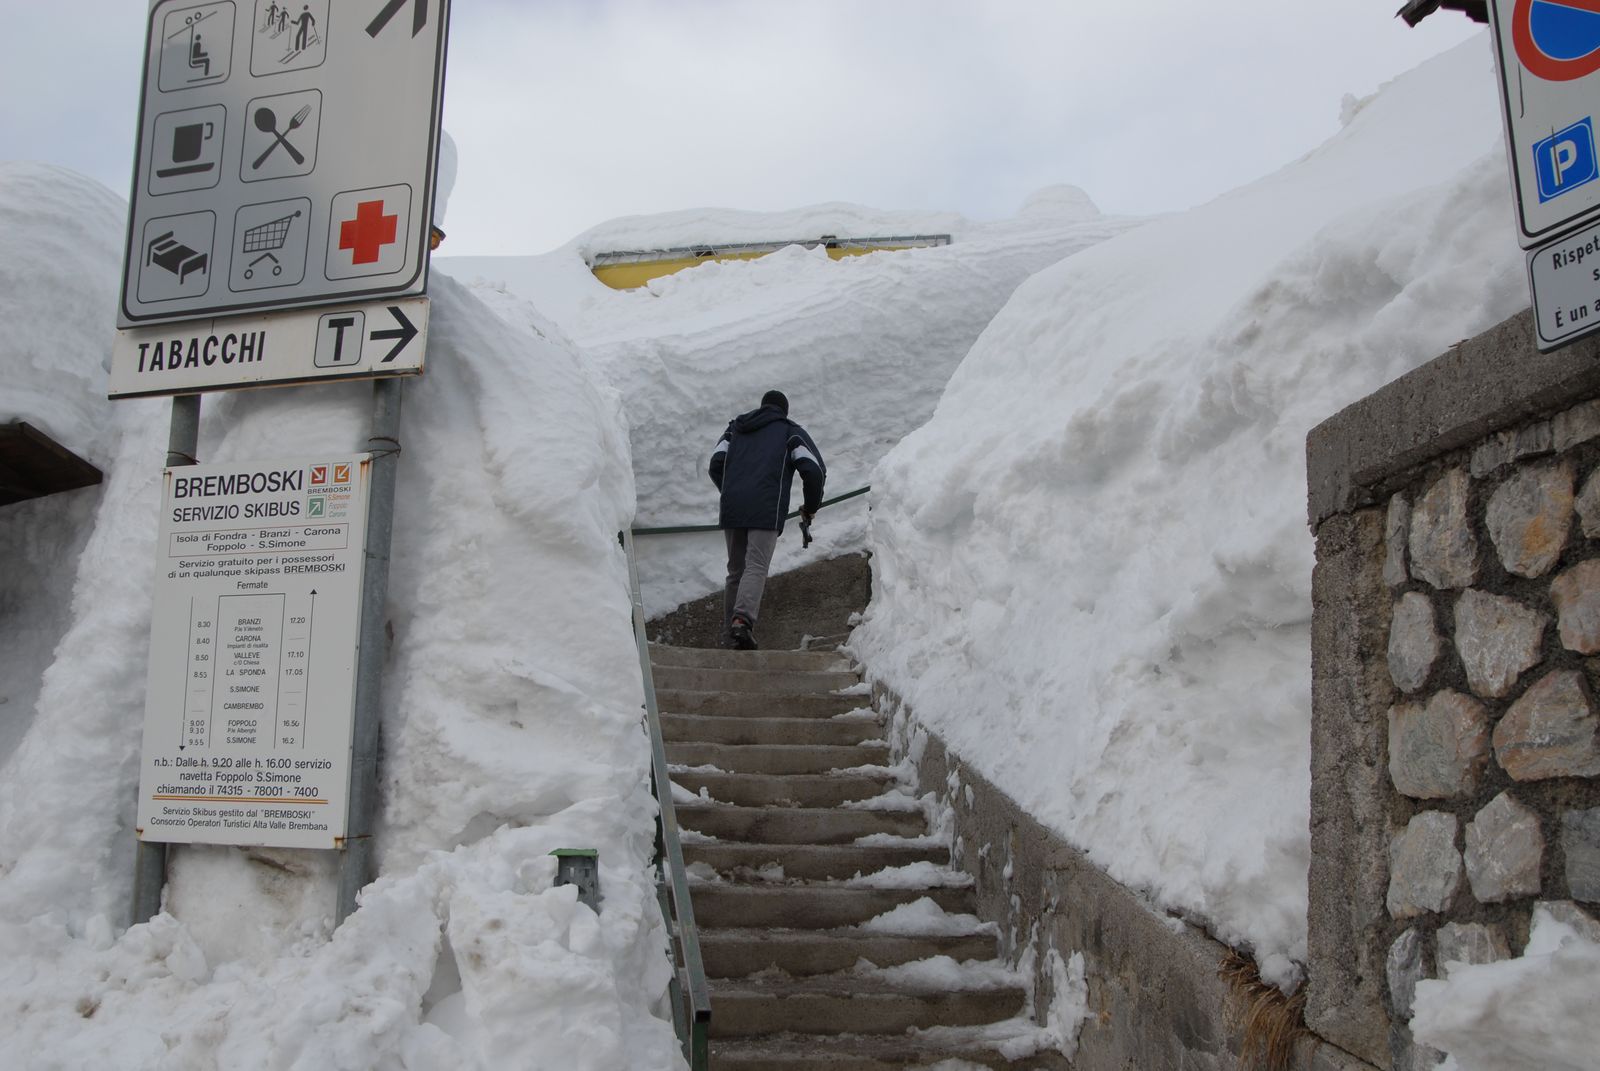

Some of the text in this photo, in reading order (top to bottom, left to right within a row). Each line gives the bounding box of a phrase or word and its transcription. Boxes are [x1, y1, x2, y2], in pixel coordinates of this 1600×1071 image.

[1550, 139, 1577, 186] P
[1570, 305, 1588, 322] un
[328, 317, 355, 361] T
[138, 331, 266, 372] TABACCHI
[174, 469, 303, 498] BREMBOSKI
[307, 486, 351, 494] BREMBOSKI
[172, 500, 300, 522] SERVIZIO SKIBUS
[176, 535, 199, 543] Isola
[202, 534, 211, 542] di
[213, 532, 247, 541] Fondra
[260, 529, 291, 538] Branzi
[303, 527, 341, 536] Carona
[207, 542, 246, 553] Foppolo
[258, 539, 306, 549] S.Simone
[179, 560, 215, 568] Servizio
[218, 557, 254, 569] gratuito
[257, 558, 273, 567] per
[281, 554, 335, 566] possessori
[168, 571, 176, 579] di
[193, 568, 241, 579] qualunque
[244, 566, 280, 576] skipass
[284, 564, 346, 574] BREMBOSKI
[237, 580, 268, 590] Fermate
[286, 668, 303, 676] 17.05
[223, 702, 264, 710] CAMBREMBO
[154, 757, 332, 769] n.b.: Dalle h. 9.20 alle h. 16.00 servizio
[180, 772, 301, 784] navetta Foppolo S.Simone
[157, 784, 206, 795] chiamando
[209, 785, 214, 795] il
[217, 785, 243, 795] 74315
[254, 786, 283, 796] 78001
[294, 787, 319, 797] 7400
[162, 807, 315, 819] Servizio Skibus gestito dal "BREMBOSKI"
[150, 817, 328, 831] Consorzio Operatori Turistici Alta Valle Brembana
